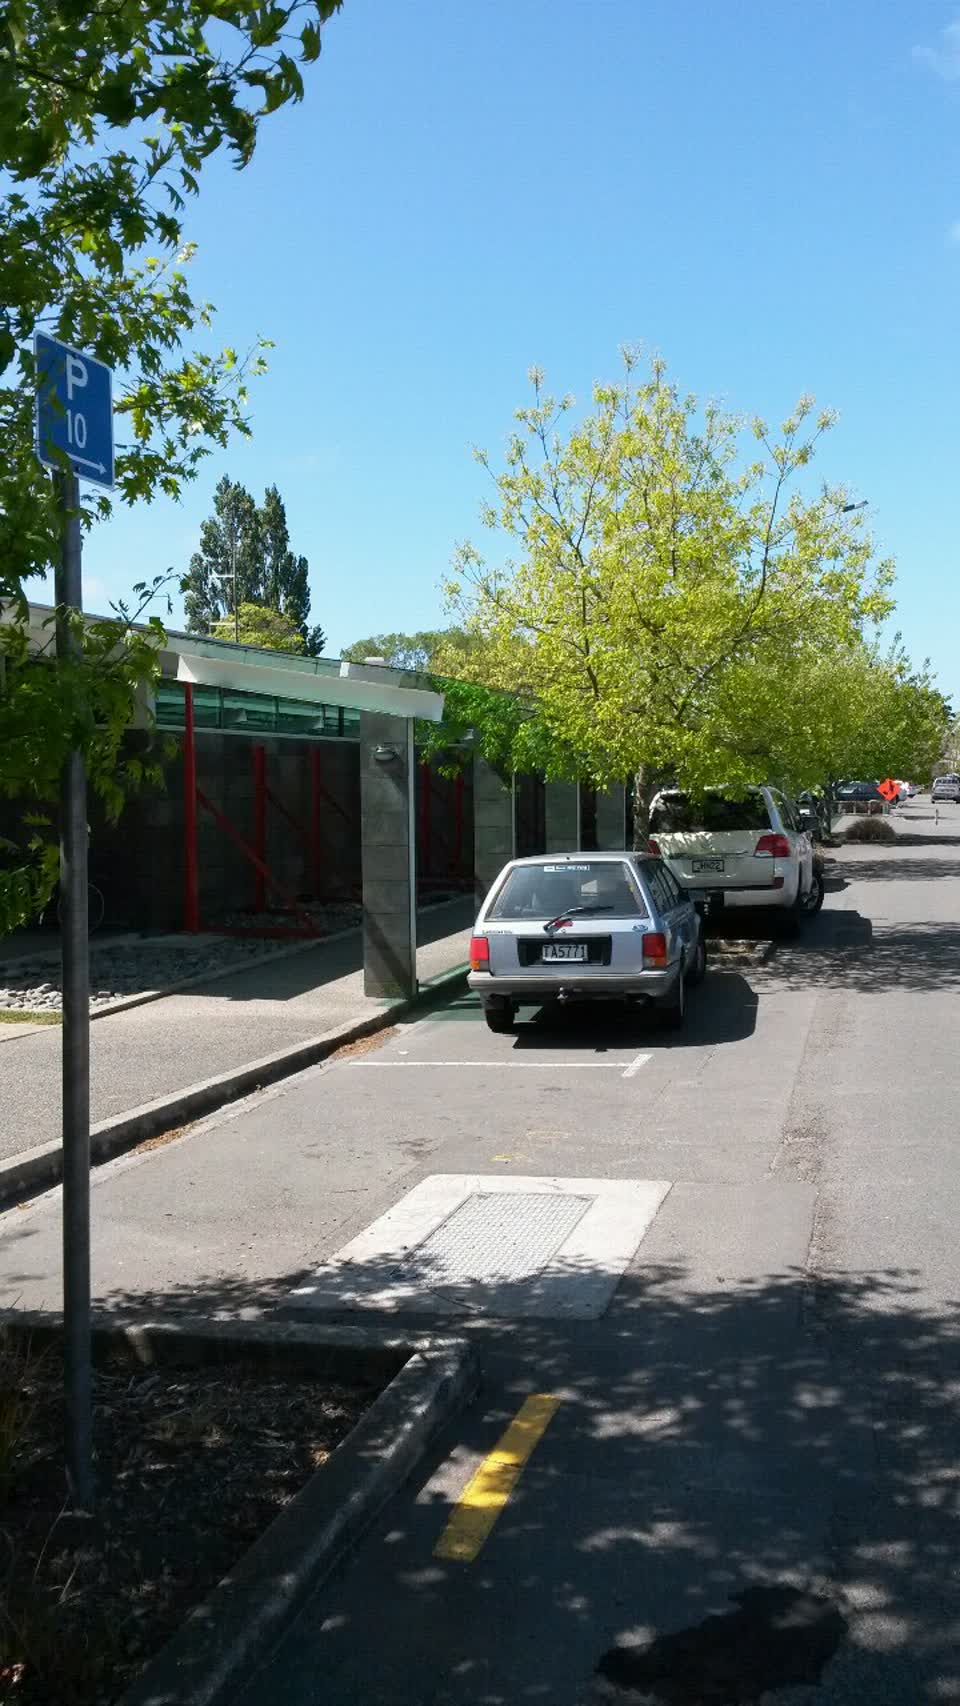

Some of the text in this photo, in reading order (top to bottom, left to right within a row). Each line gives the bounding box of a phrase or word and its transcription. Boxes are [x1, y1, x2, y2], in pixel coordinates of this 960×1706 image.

[66, 353, 89, 401] P
[66, 409, 87, 449] 10
[543, 945, 585, 958] TA5771
